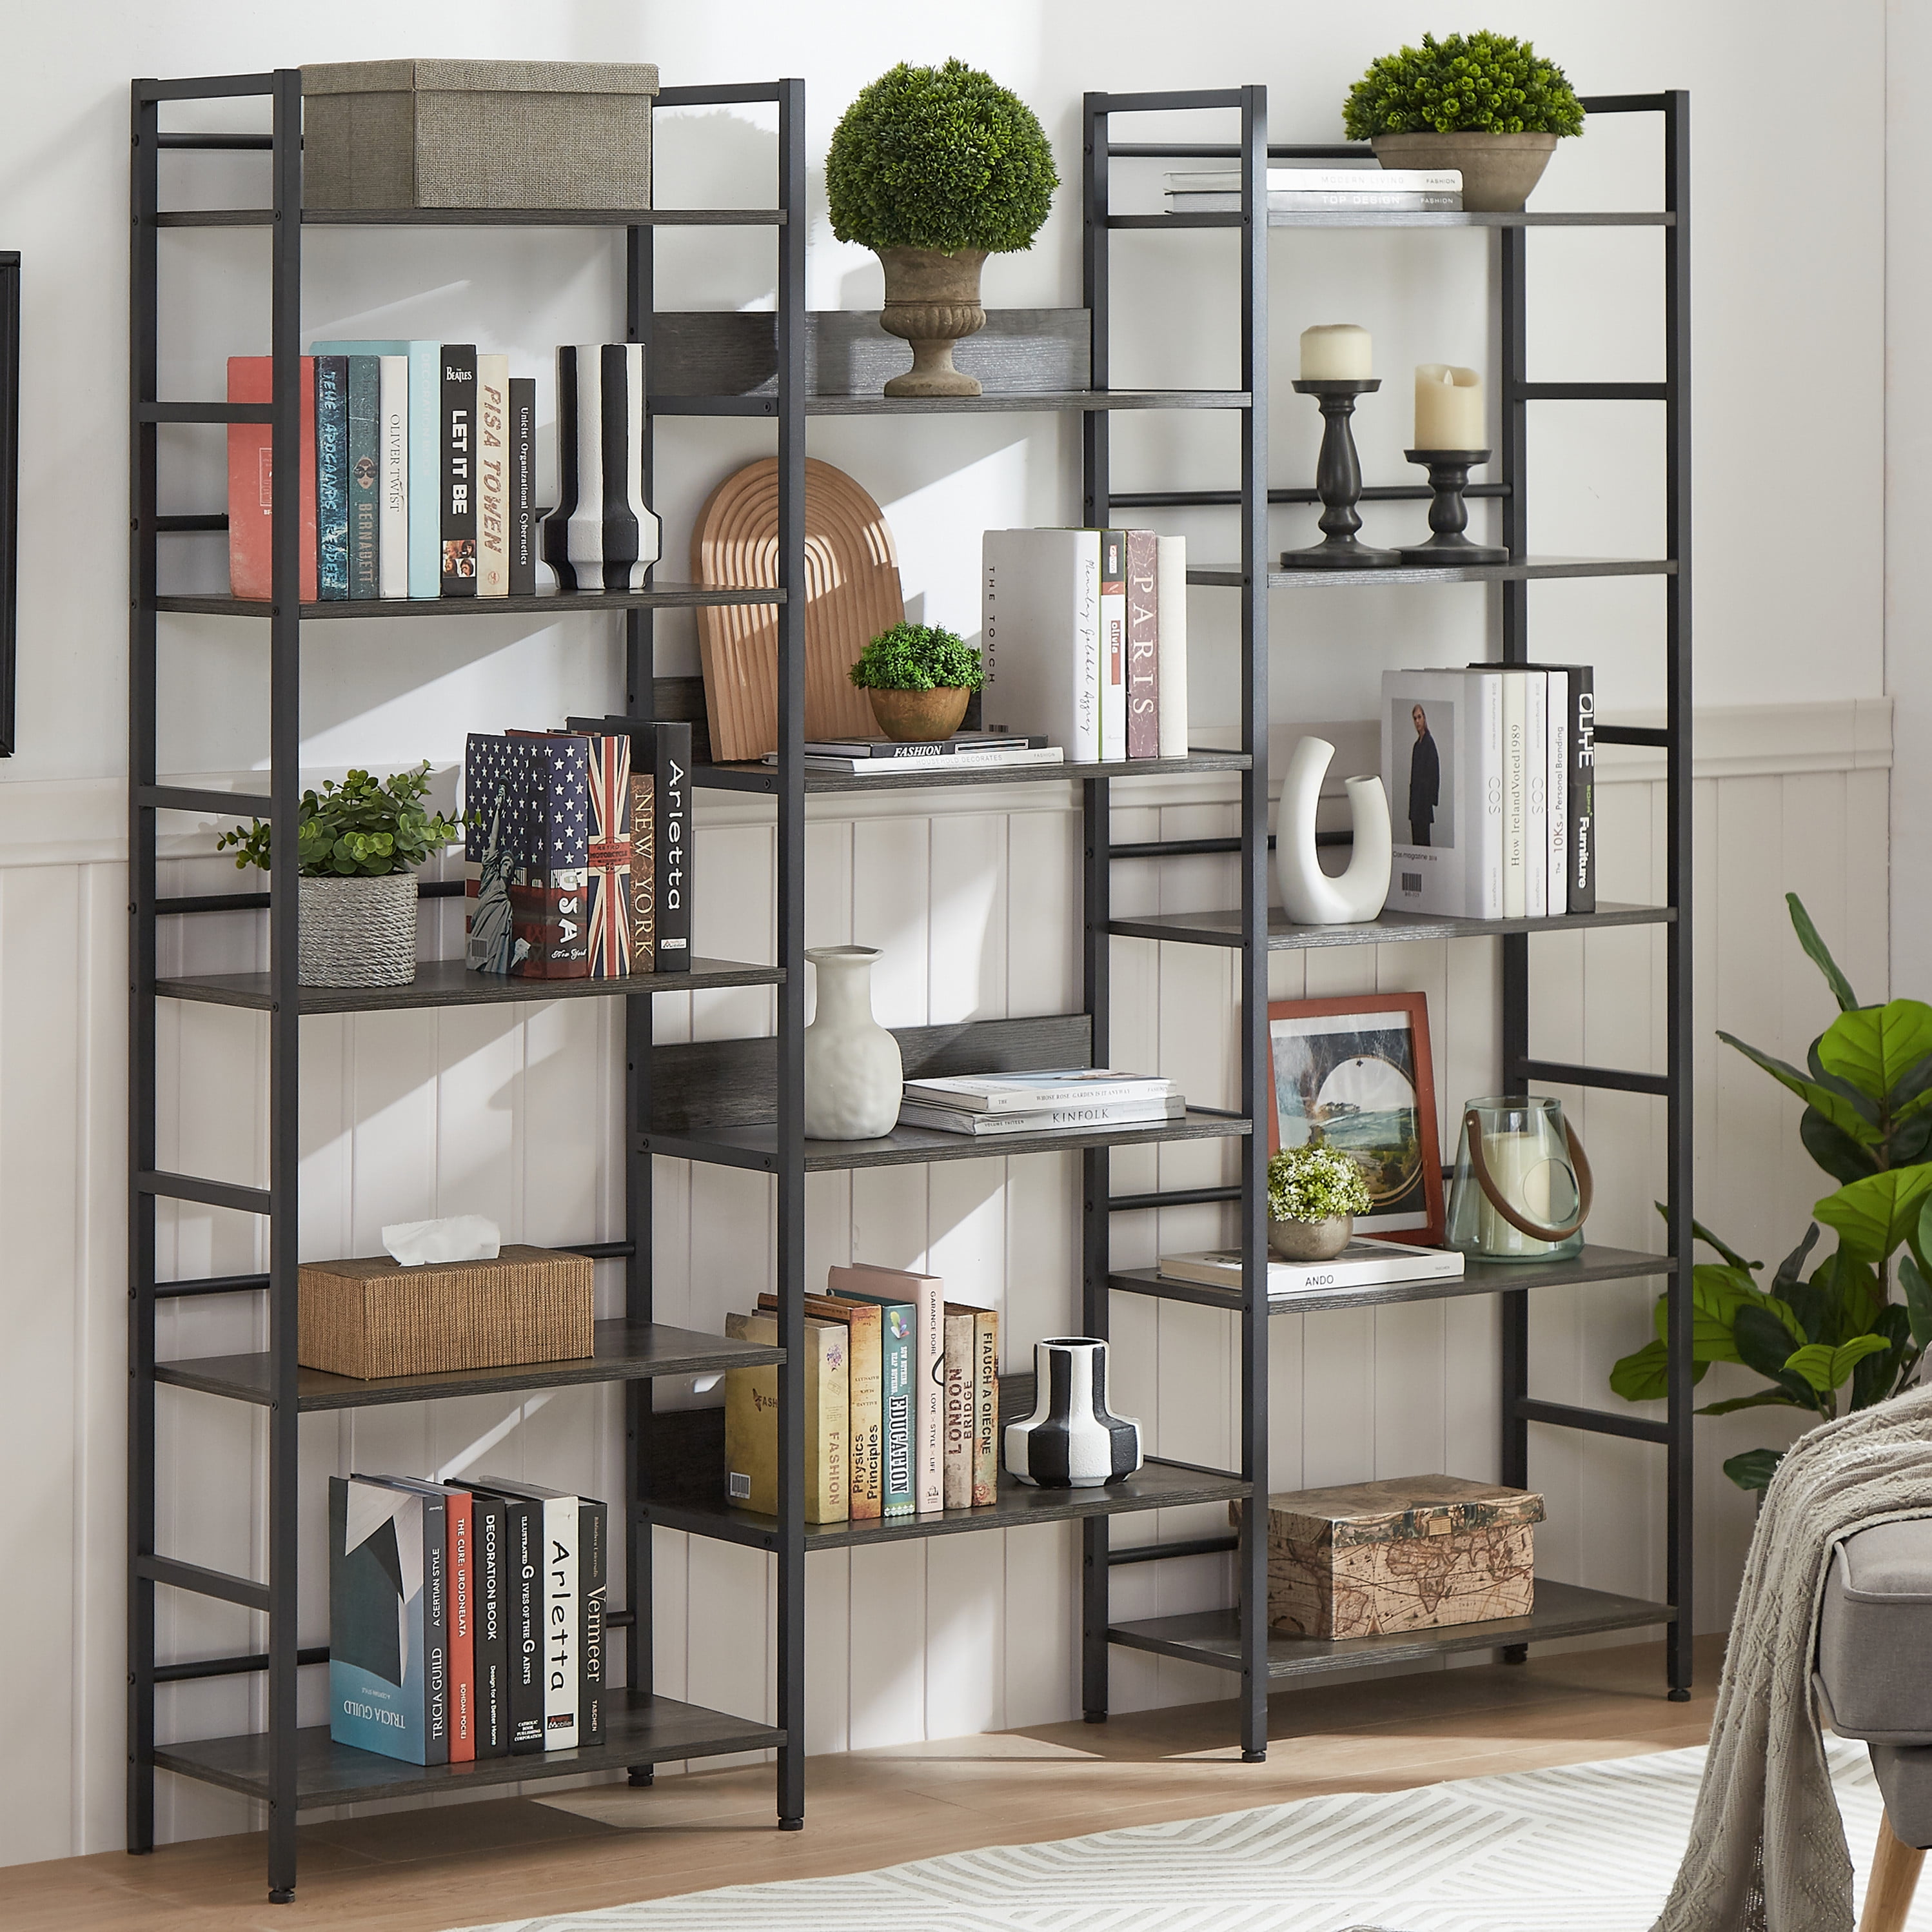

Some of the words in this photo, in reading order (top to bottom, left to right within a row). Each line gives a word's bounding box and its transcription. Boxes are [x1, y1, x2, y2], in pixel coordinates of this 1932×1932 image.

[1323, 196, 1346, 204] TOP
[1354, 195, 1400, 204] DESIGN
[451, 409, 468, 451] LET
[483, 384, 502, 448] PISA
[520, 406, 529, 439] Unicist
[391, 413, 400, 464] OLIVER
[451, 457, 468, 478] IT
[519, 442, 529, 509] Organizational
[390, 468, 404, 513] TWIST
[451, 484, 468, 515] BE
[519, 512, 529, 566] Cybernetics
[1111, 621, 1121, 654] olivia
[1132, 574, 1154, 714] PARIS
[894, 745, 943, 757] FASHION
[916, 756, 960, 765] HOUSEHOLD
[961, 754, 1002, 764] DECORATES
[1555, 727, 1564, 769] Branding
[1489, 776, 1501, 815] COS
[1532, 776, 1543, 815] COS
[635, 793, 654, 859] NEW
[668, 759, 685, 910] Arletta
[1553, 822, 1563, 853] 10Ks
[1511, 835, 1520, 867] How
[1579, 816, 1589, 889] Furniture
[557, 870, 578, 943] USA
[635, 875, 654, 959] YORK
[1053, 1109, 1109, 1123] KINFOLK
[1305, 1274, 1334, 1287] ANDO
[982, 1332, 992, 1385] FIAUCH
[758, 1395, 778, 1408] FASH
[949, 1368, 962, 1455] LONDON
[963, 1381, 972, 1440] BRIDGE
[982, 1389, 992, 1399] A
[852, 1434, 866, 1493] Physics
[867, 1424, 880, 1500] Principles
[890, 1396, 907, 1493] EDUCATION
[829, 1432, 840, 1505] FASHION
[432, 1548, 440, 1577] STYLE
[486, 1514, 496, 1601] DECORATION
[432, 1579, 441, 1617] CERTIAN
[522, 1606, 530, 1618] OF
[551, 1540, 571, 1691] Arletta
[432, 1619, 440, 1627] A
[486, 1604, 497, 1641] BOOK
[586, 1584, 606, 1682] Vermeer
[431, 1648, 443, 1691] GUILD
[343, 1700, 373, 1720] GUILD
[374, 1708, 406, 1730] TRICIA
[432, 1692, 443, 1740] TRICIA
